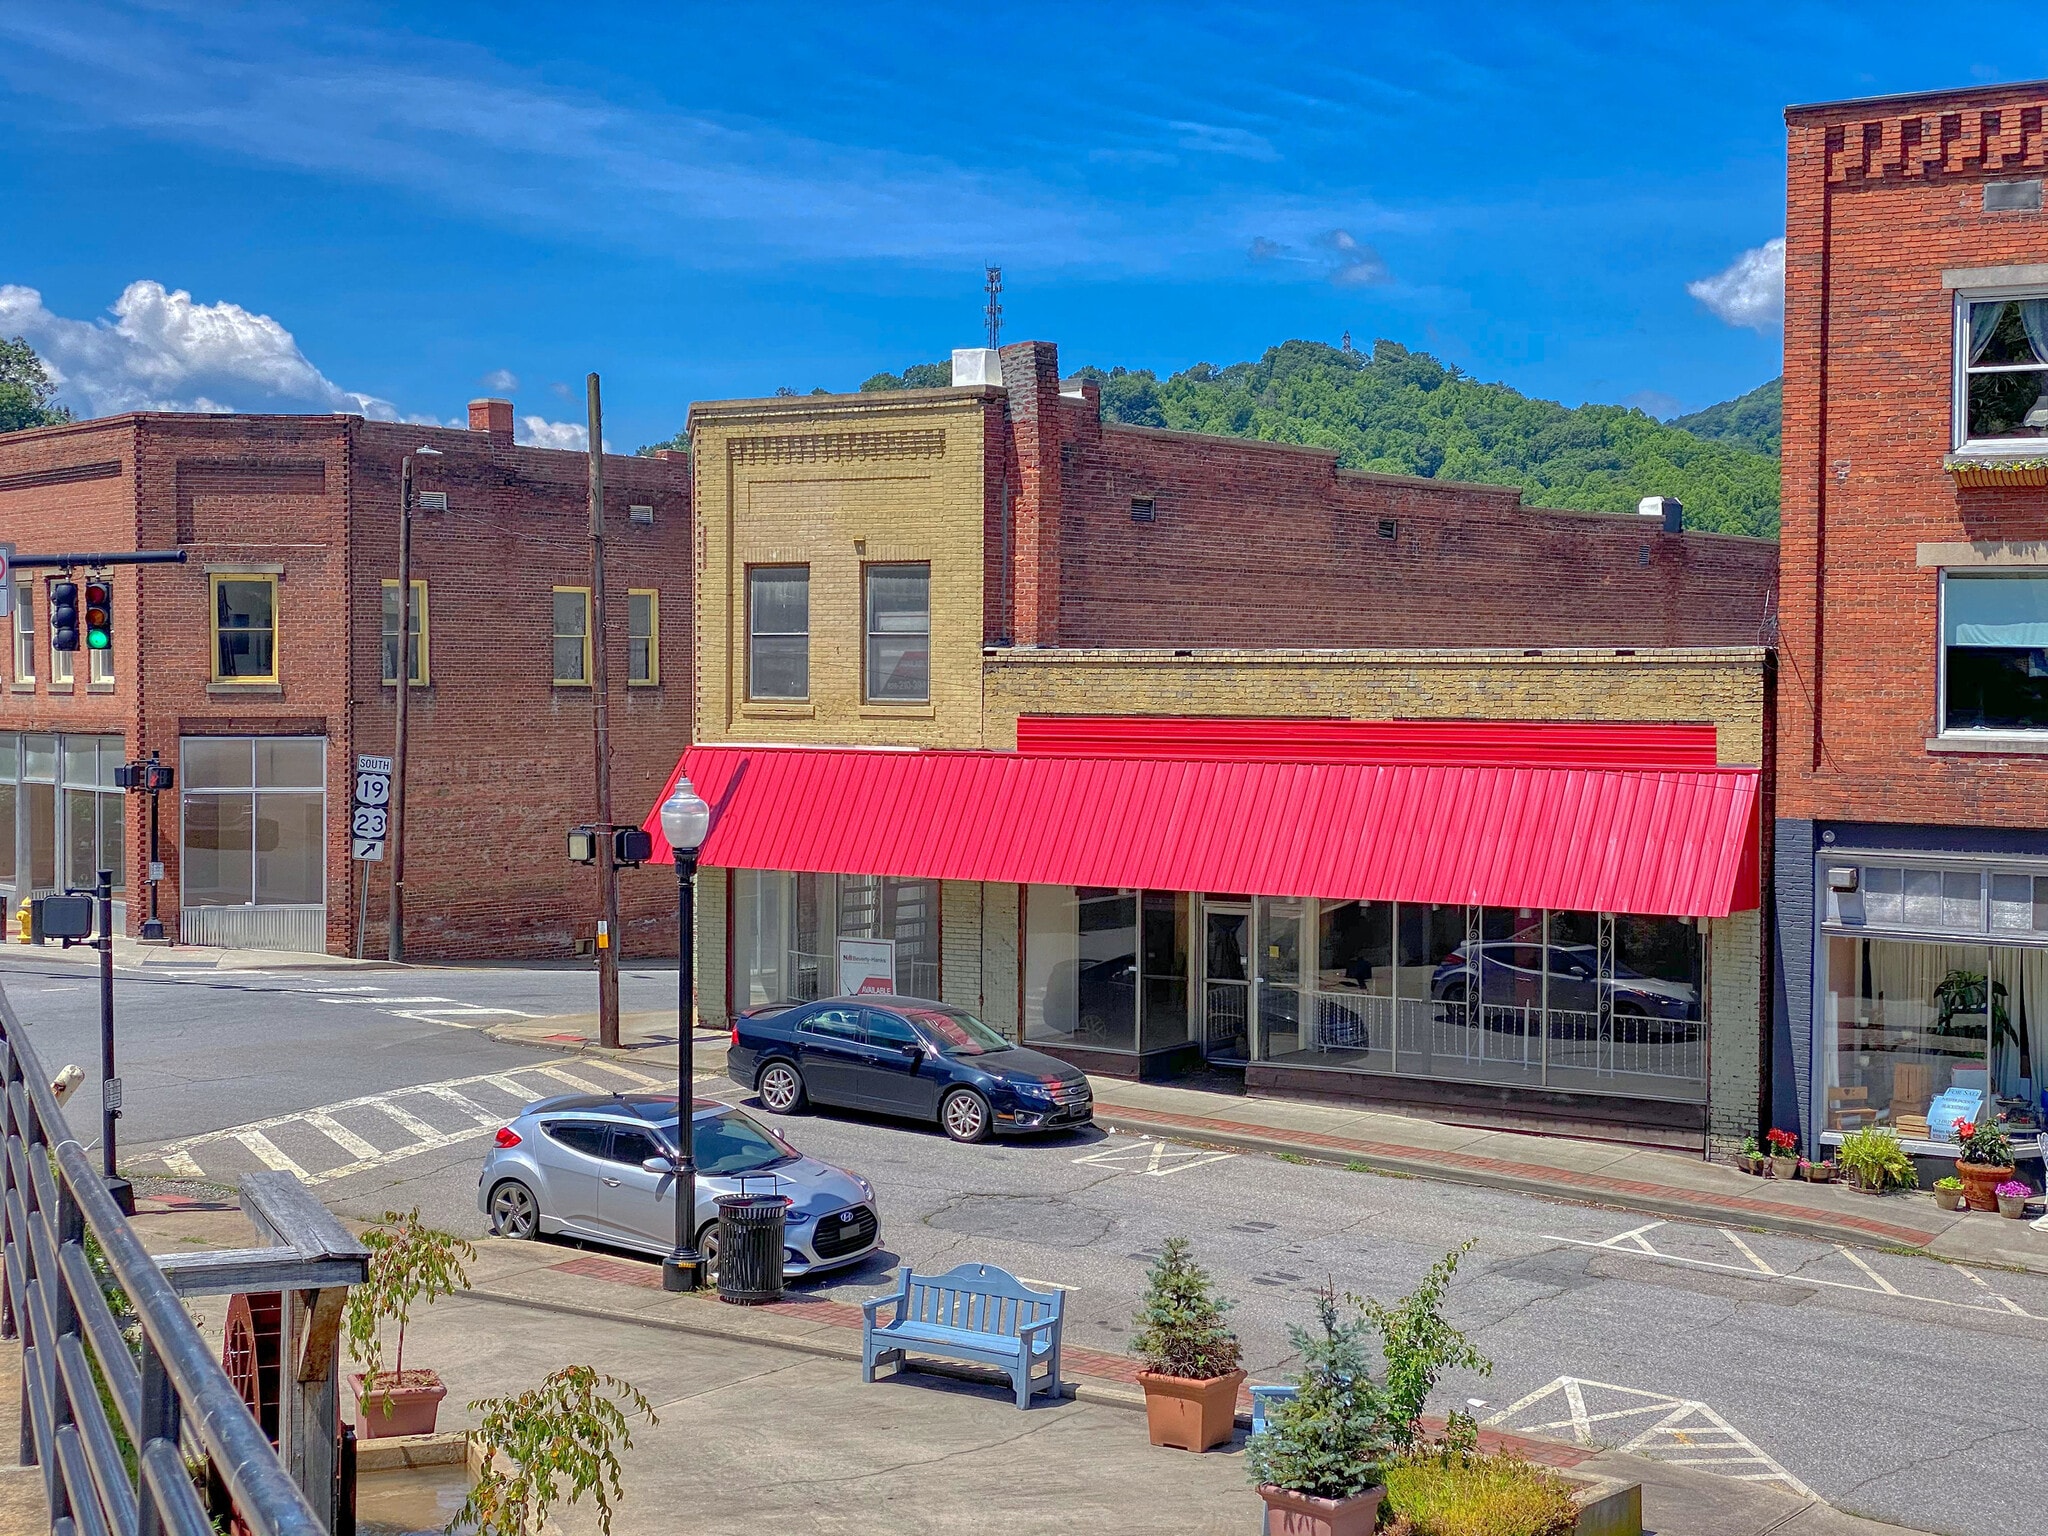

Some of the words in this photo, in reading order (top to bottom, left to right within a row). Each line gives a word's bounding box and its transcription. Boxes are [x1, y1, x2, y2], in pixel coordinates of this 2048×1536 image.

[360, 758, 389, 770] SOUTH
[363, 780, 384, 798] 19
[356, 814, 383, 832] 23
[862, 986, 891, 994] AVAILABLE
